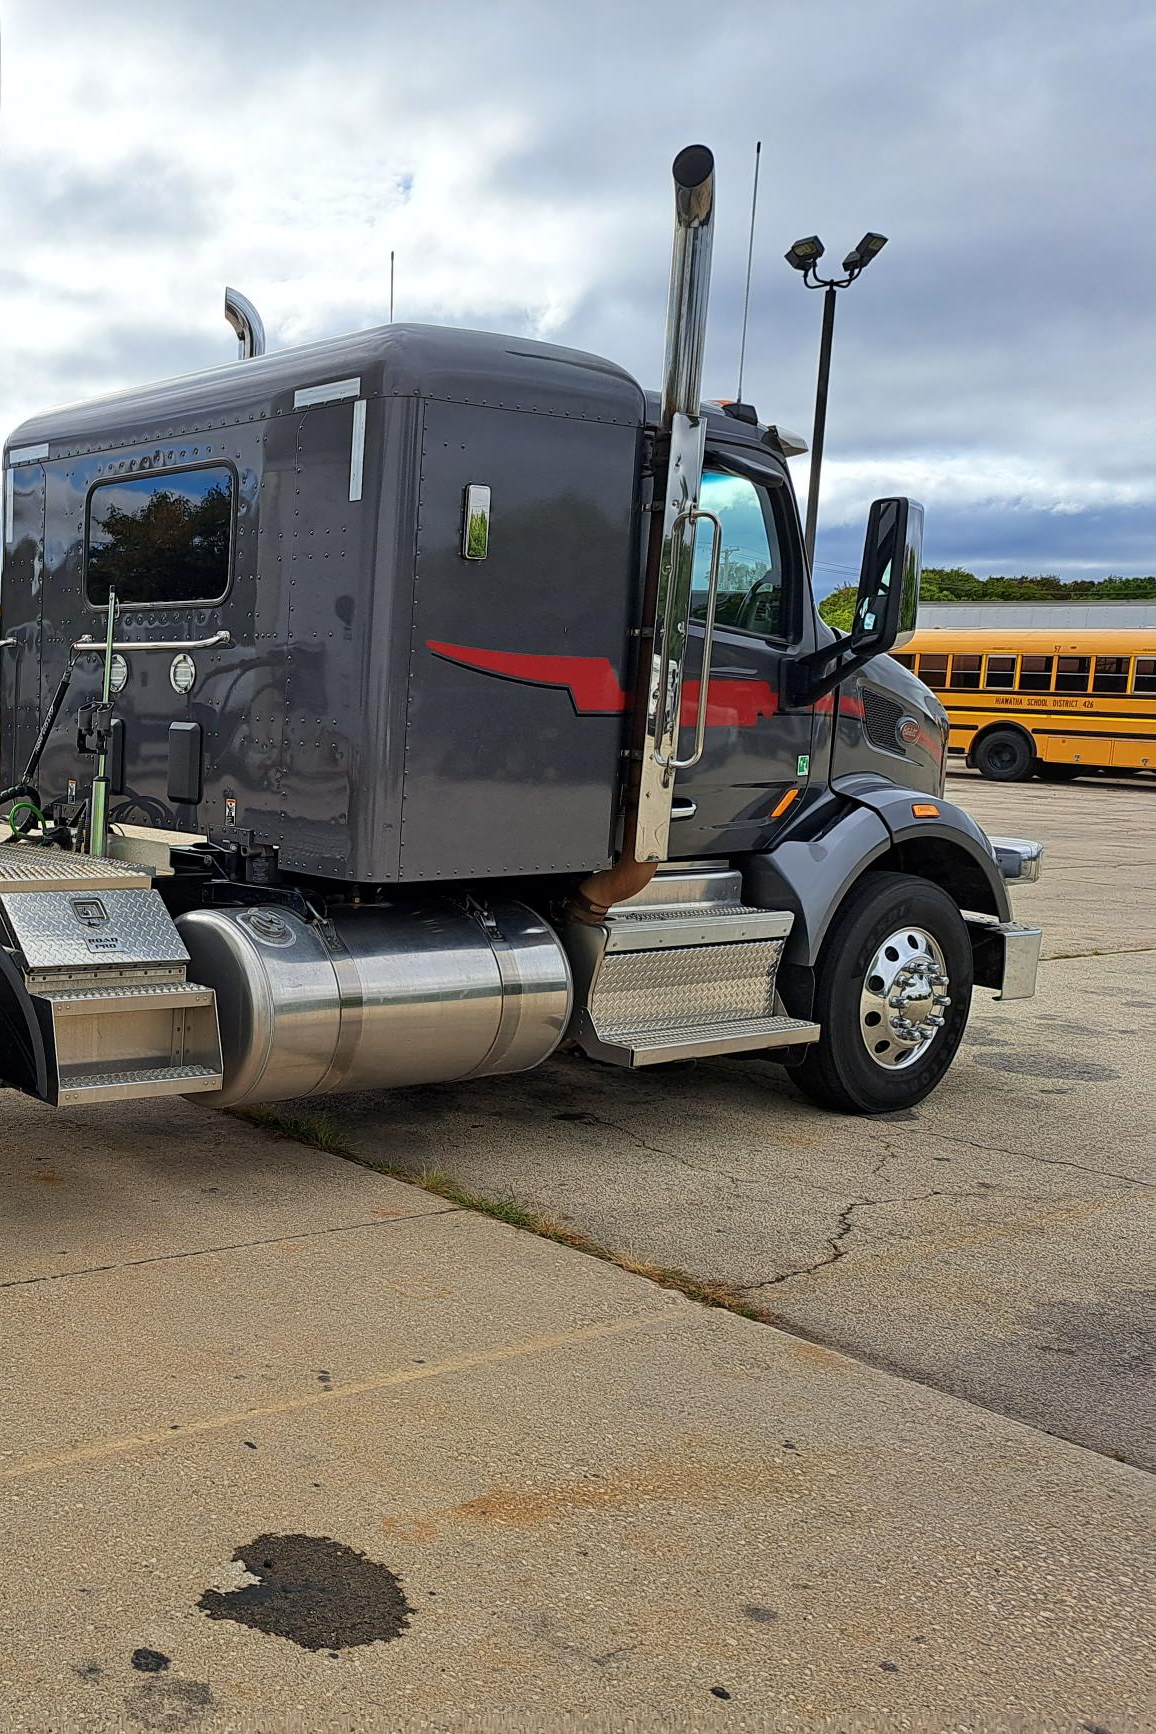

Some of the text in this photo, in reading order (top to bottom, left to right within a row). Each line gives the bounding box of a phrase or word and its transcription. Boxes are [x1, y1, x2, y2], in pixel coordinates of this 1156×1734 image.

[995, 697, 1094, 709] HIAWATHA SCHOOL DISTRICT 426
[88, 937, 119, 945] ROAD
